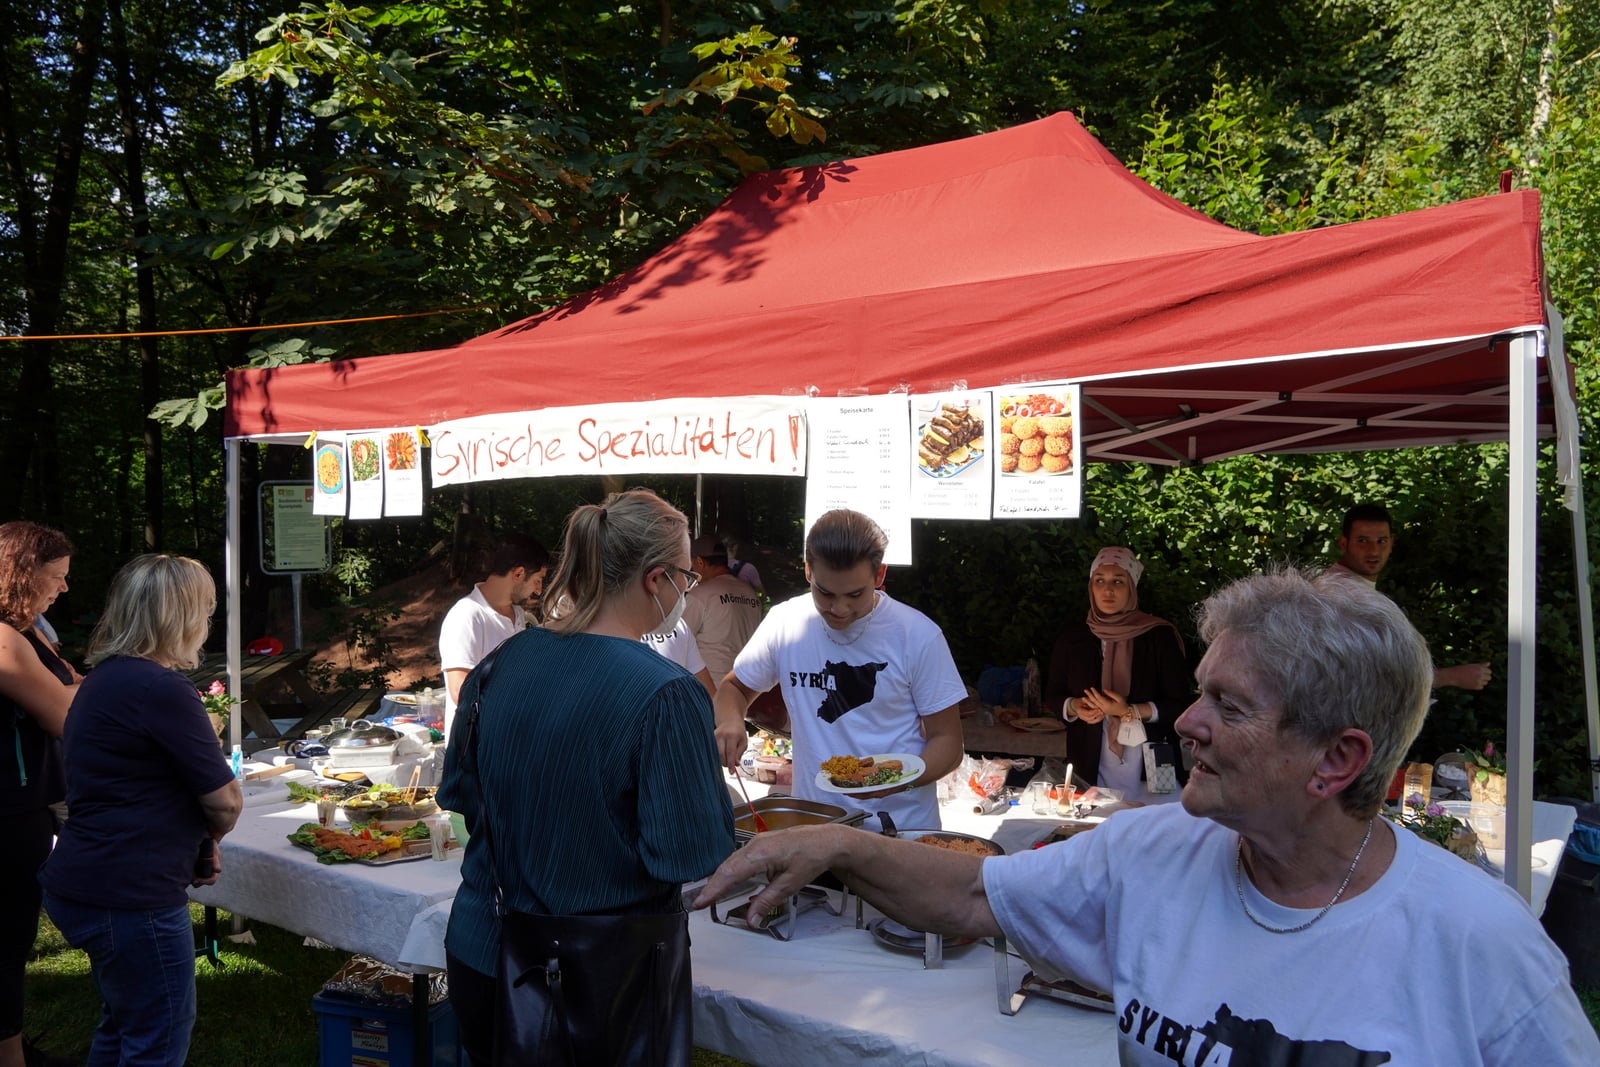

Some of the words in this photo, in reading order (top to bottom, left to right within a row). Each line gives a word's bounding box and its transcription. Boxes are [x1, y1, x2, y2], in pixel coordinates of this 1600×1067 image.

[839, 407, 874, 415] Speisekarte
[436, 424, 566, 480] Syrische
[789, 671, 837, 691] SYRIA
[1118, 998, 1233, 1067] SYRIA
